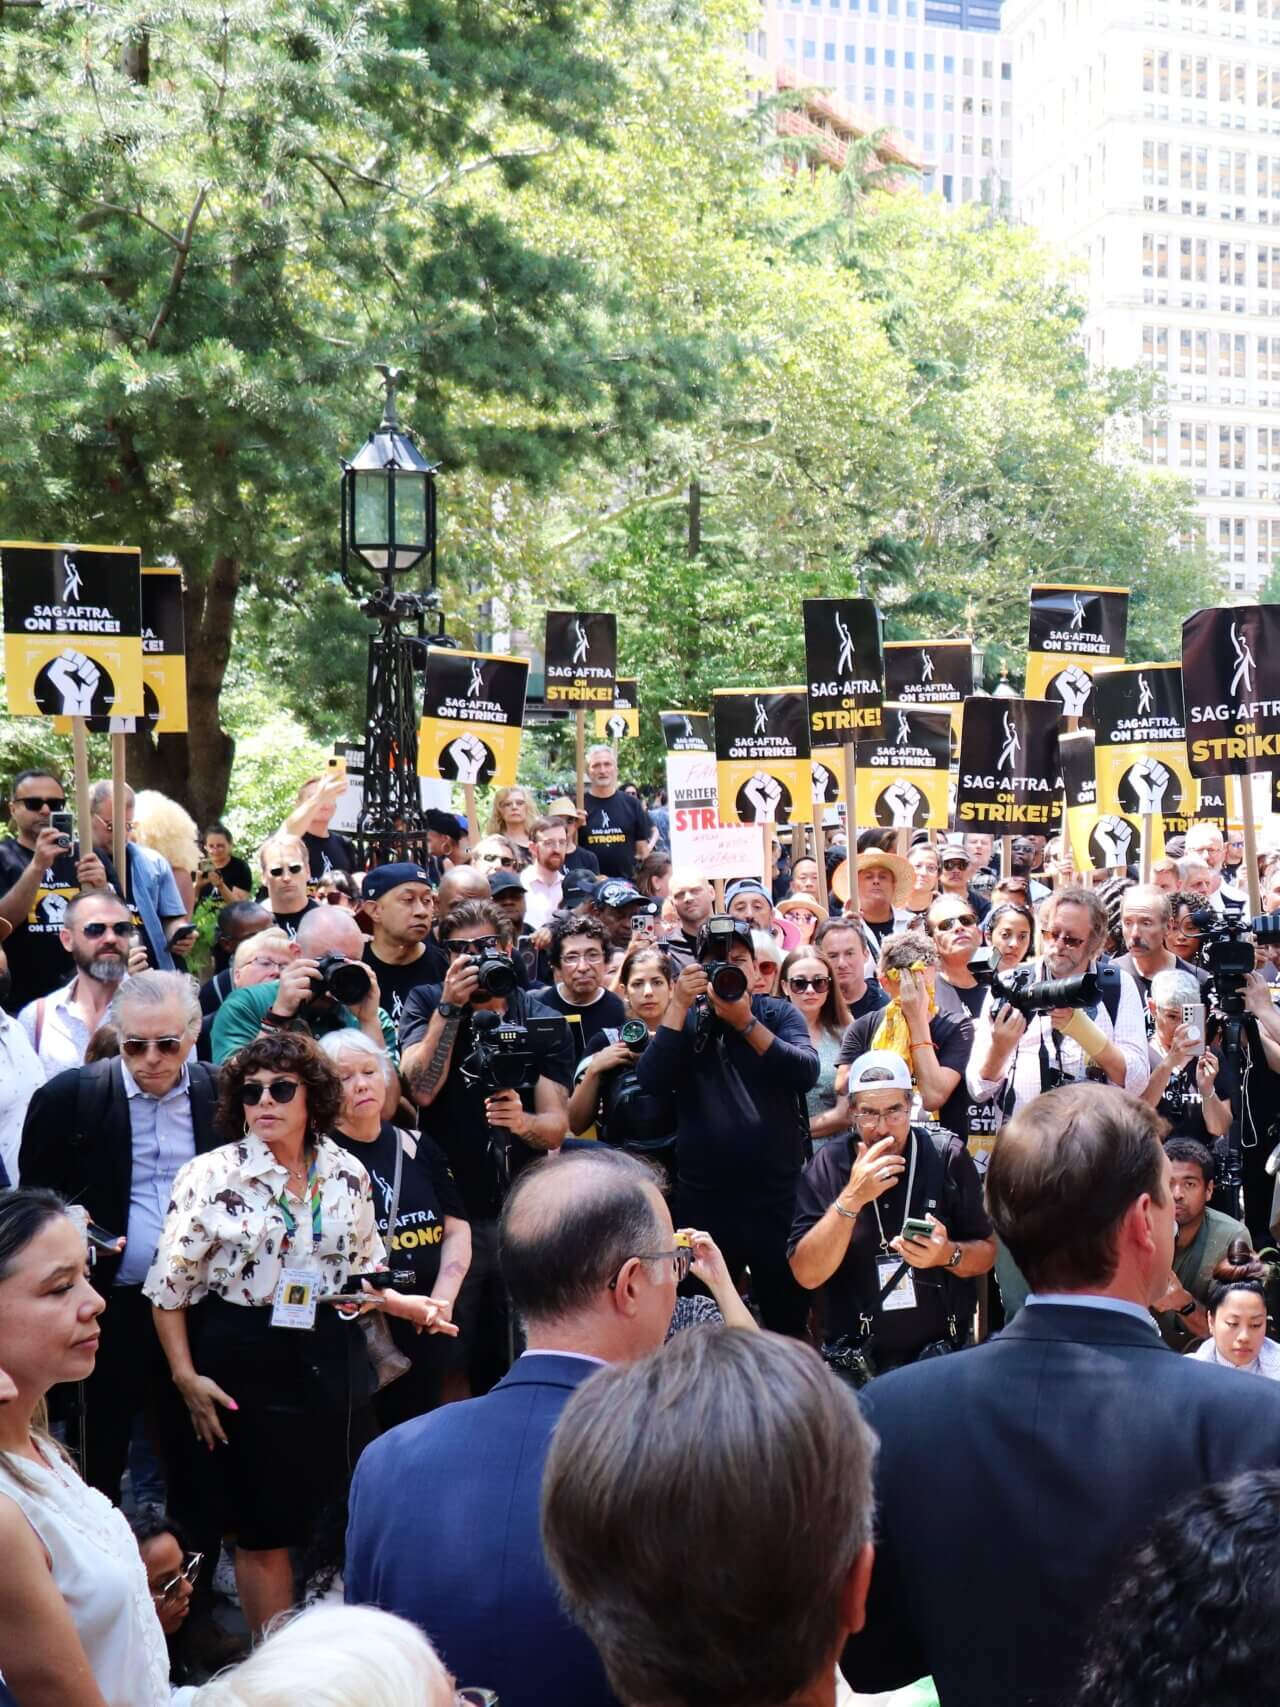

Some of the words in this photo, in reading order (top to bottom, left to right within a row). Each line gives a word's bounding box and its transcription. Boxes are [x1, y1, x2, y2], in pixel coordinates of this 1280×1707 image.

[24, 618, 51, 630] ON
[56, 619, 120, 632] STRIKE!
[1043, 640, 1060, 650] ON
[1064, 642, 1110, 653] STRIKE!
[574, 679, 587, 687] ON
[546, 687, 613, 700] STRIKE!
[899, 693, 916, 702] ON
[919, 692, 960, 701] STRIKE!
[842, 698, 855, 708] ON
[437, 706, 458, 718] ON
[459, 709, 508, 723] STRIKE!
[812, 708, 881, 731] STRIKE!
[1110, 730, 1131, 741] ON
[1133, 727, 1185, 740] STRIKE!
[1234, 723, 1256, 735] ON
[729, 747, 747, 757] ON
[750, 747, 797, 757] STRIKE!
[870, 756, 888, 766] ON
[891, 756, 936, 767] STRIKE!
[674, 787, 717, 800] WRITER
[997, 794, 1015, 802] ON
[960, 802, 1048, 823] STRIKE!
[588, 834, 625, 844] STRONG
[28, 924, 44, 932] ON
